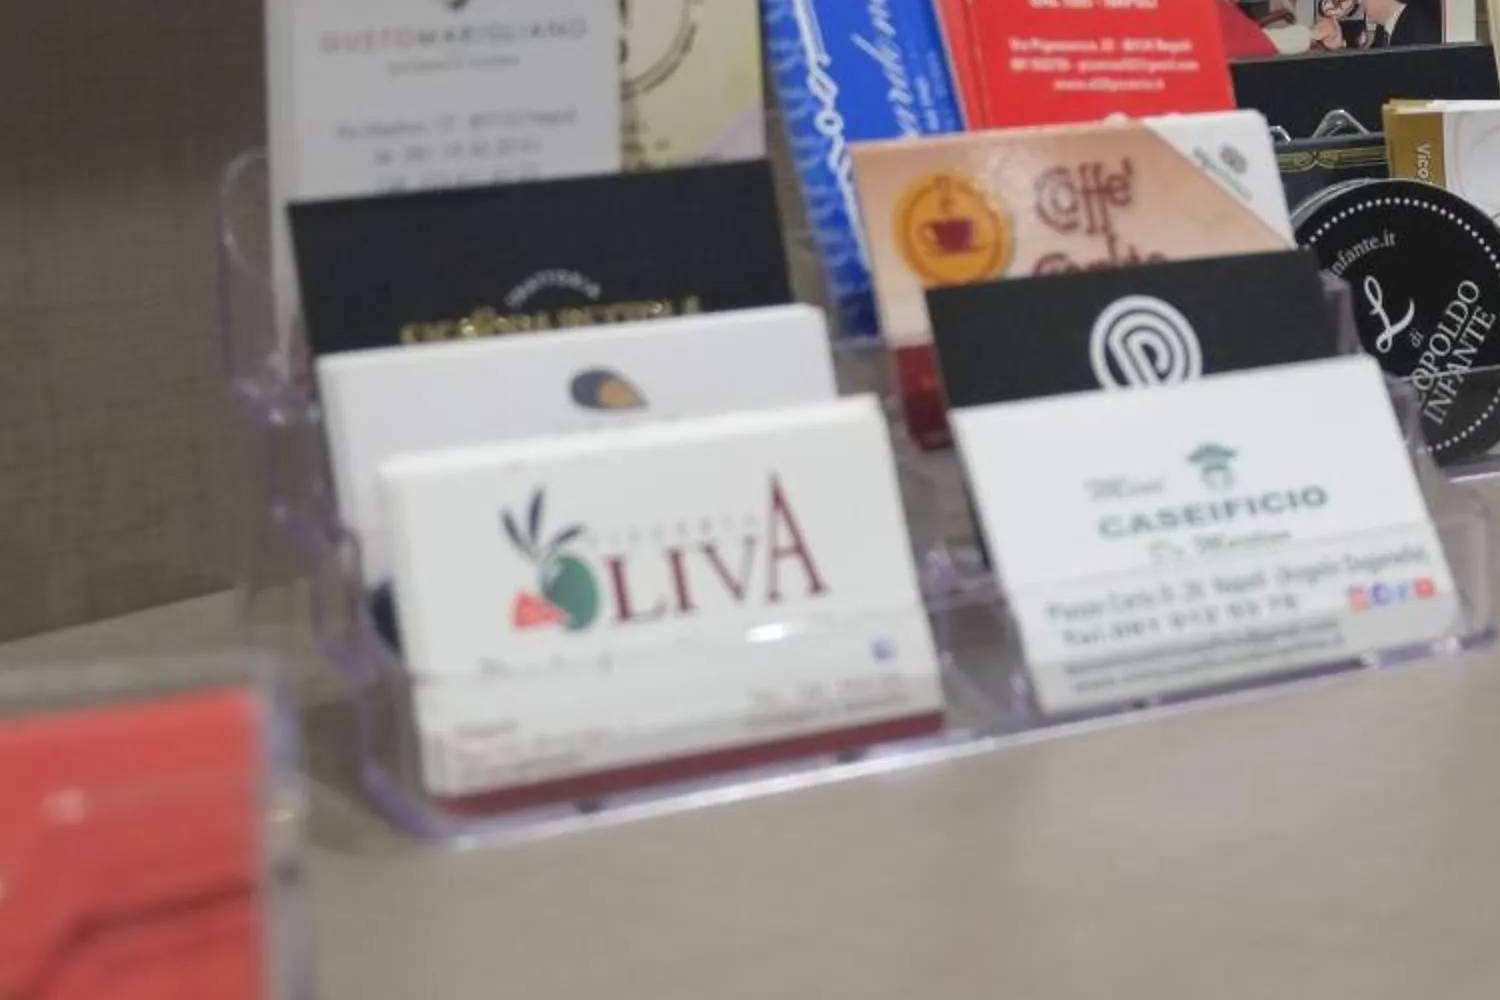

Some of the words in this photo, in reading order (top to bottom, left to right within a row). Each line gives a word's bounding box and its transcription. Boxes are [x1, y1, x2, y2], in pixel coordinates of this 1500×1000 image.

[1332, 228, 1397, 277] nfante.it
[1411, 279, 1480, 398] OPOLDO
[1423, 305, 1497, 426] INFANTE
[1097, 483, 1330, 541] CASEIFICIO
